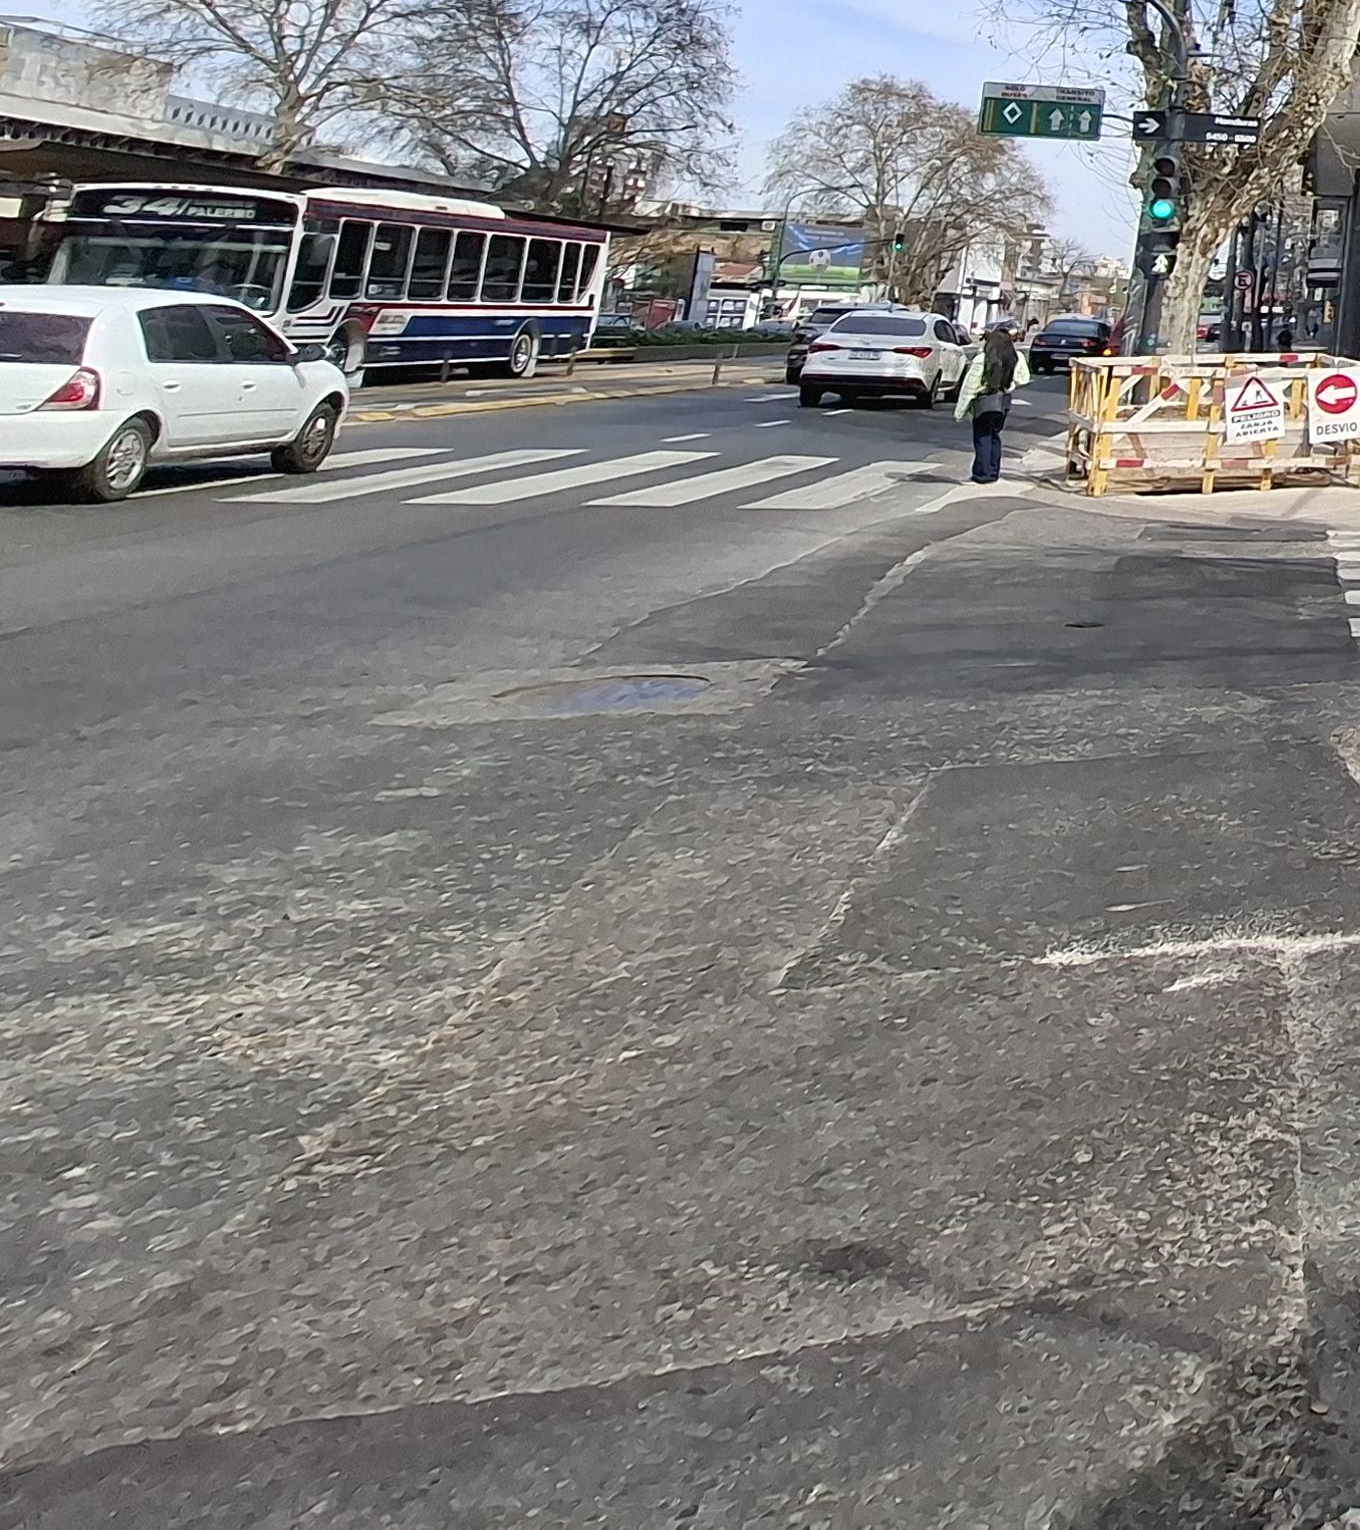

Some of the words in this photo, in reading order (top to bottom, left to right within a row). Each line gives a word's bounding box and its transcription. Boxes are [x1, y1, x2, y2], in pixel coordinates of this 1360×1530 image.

[186, 206, 256, 219] PALERMO
[1232, 410, 1279, 423] PELIGRO
[1235, 426, 1279, 437] ABIERTA
[1240, 420, 1273, 430] ZANJA
[1316, 421, 1358, 436] DESVIO
